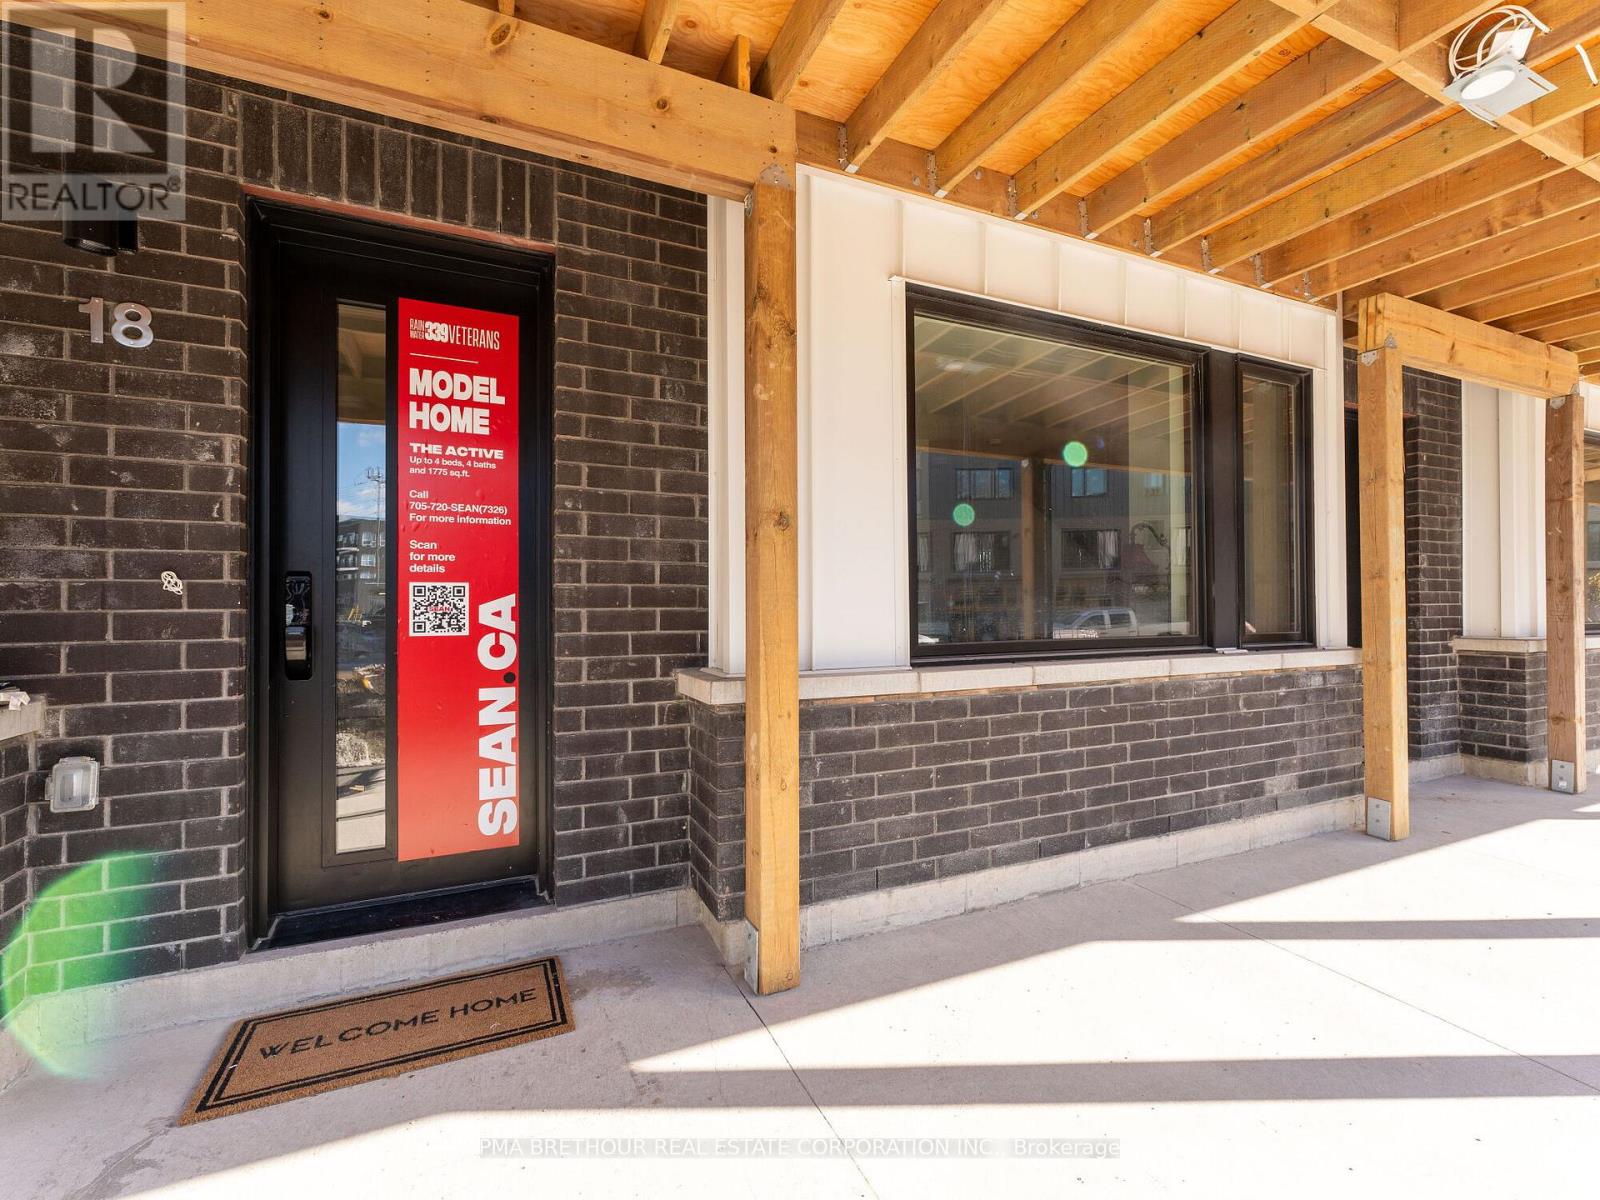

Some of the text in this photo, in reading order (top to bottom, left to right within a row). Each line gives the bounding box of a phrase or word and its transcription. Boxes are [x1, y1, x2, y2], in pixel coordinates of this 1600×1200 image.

[78, 297, 154, 348] 18
[449, 325, 500, 350] VETERANS
[409, 368, 505, 405] MODEL
[409, 401, 490, 435] HOME
[409, 443, 504, 459] THE ACTIVE
[409, 456, 422, 466] Up
[424, 457, 433, 465] to
[473, 461, 496, 469] baths
[409, 467, 426, 475] and
[428, 468, 448, 476] 1775
[409, 489, 429, 499] Call
[409, 502, 507, 515] 705-720-SEAN(7326)
[409, 513, 511, 525] For more information
[409, 540, 437, 549] Scan
[409, 552, 456, 562] for more
[409, 564, 446, 573] details
[477, 593, 518, 836] SEAN.CA
[259, 988, 537, 1059] WELCOME HOME
